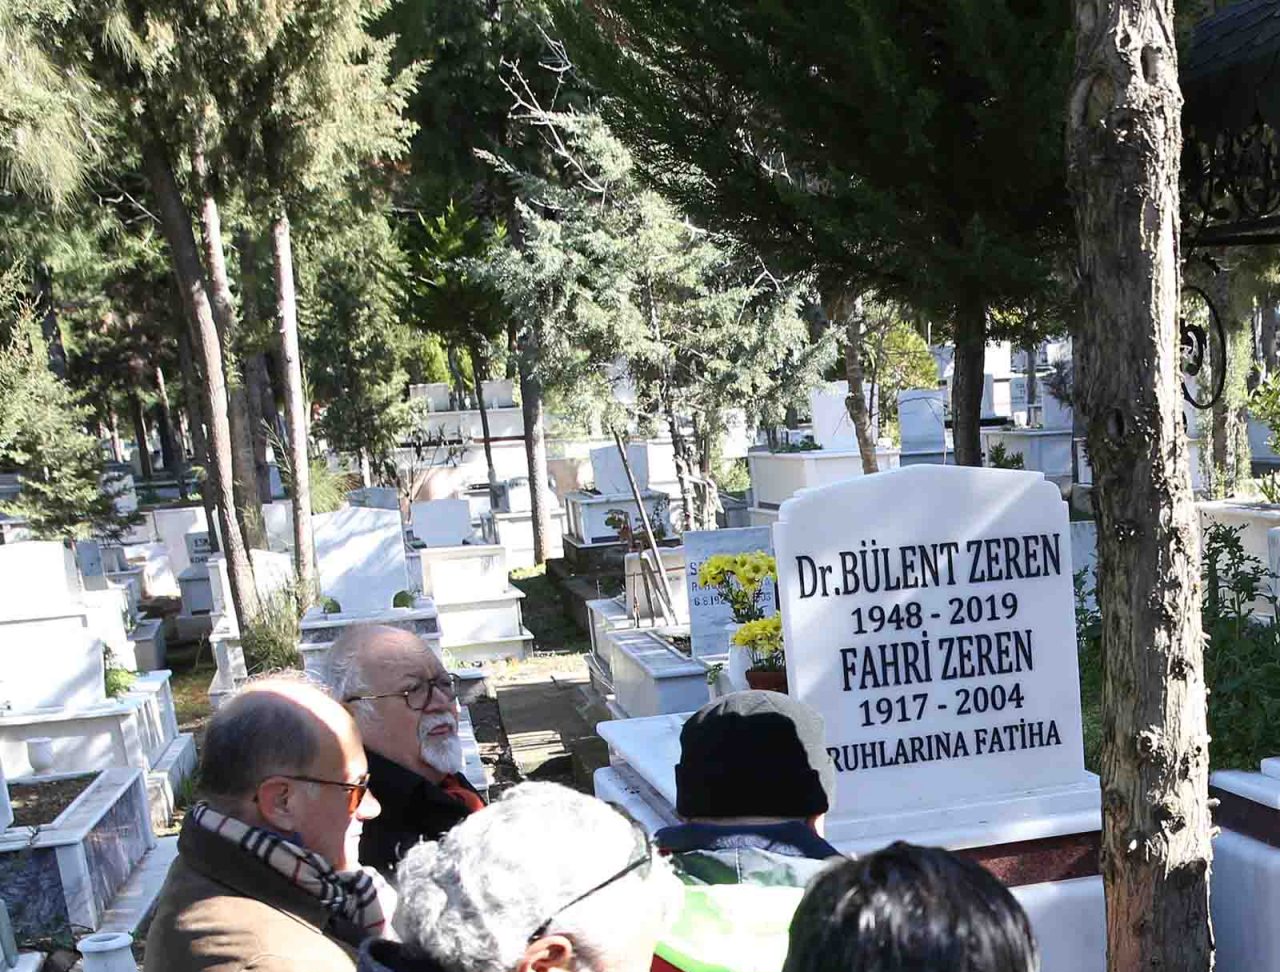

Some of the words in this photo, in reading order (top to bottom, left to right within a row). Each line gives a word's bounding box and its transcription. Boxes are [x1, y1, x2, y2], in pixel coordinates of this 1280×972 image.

[795, 540, 959, 599] Dr.BÜLENT
[966, 533, 1062, 584] ZEREN
[850, 601, 923, 635] 1948
[948, 592, 1019, 625] 2019
[839, 630, 933, 691] FAHRİ
[938, 629, 1034, 681] ZEREN
[859, 693, 929, 727] 1917
[955, 683, 1025, 716] 2004
[826, 731, 968, 772] RUHLARINA
[974, 718, 1062, 756] FATİHA
